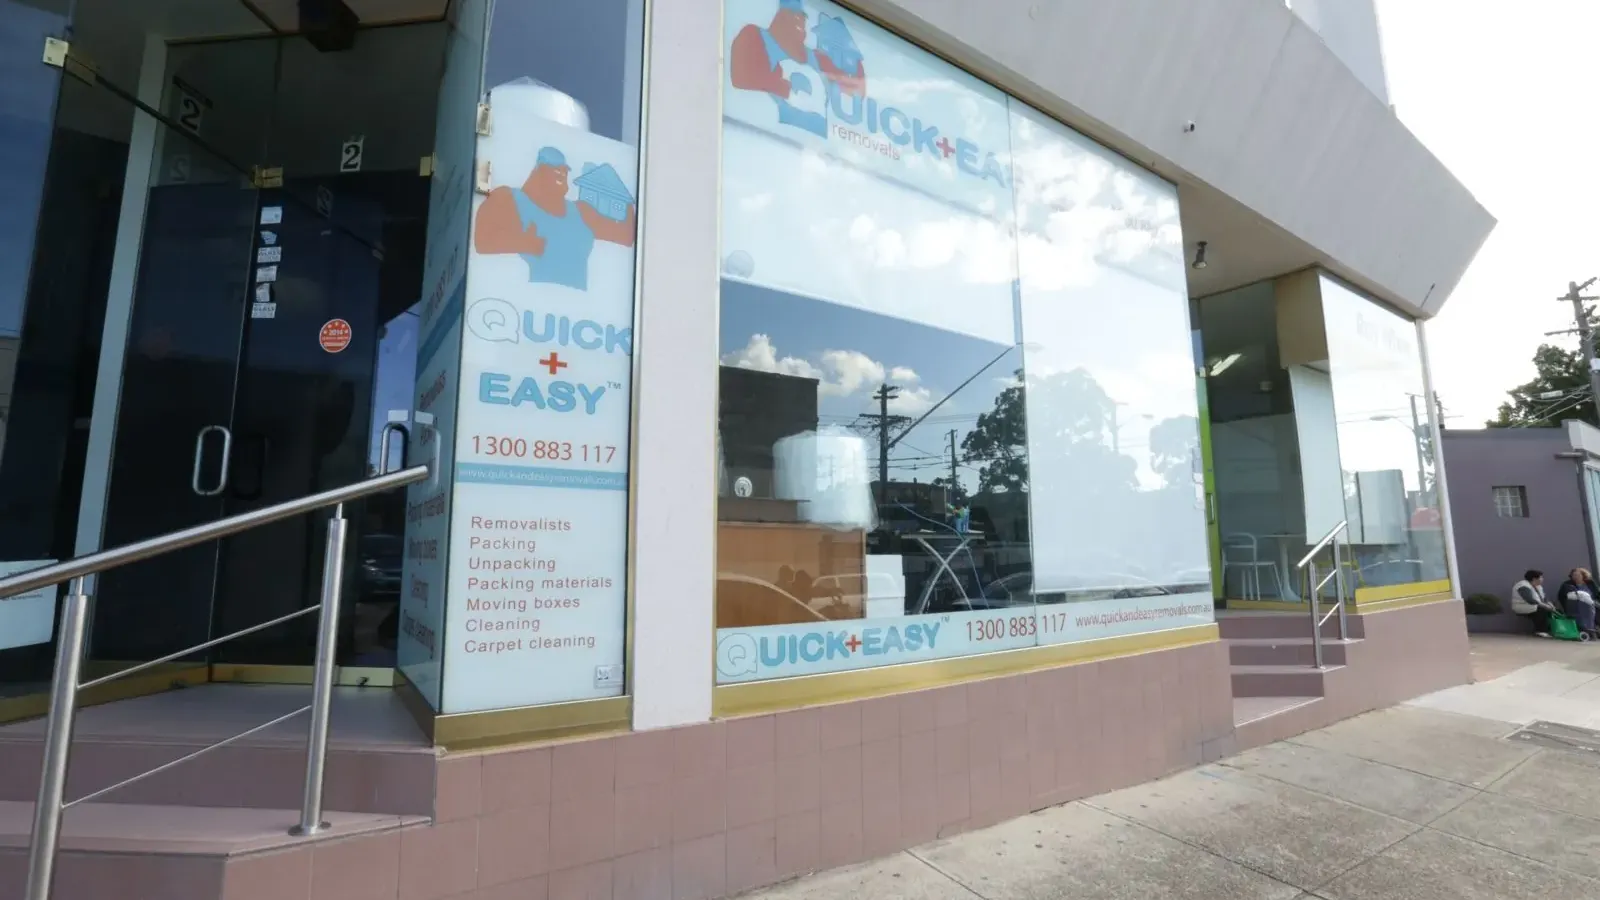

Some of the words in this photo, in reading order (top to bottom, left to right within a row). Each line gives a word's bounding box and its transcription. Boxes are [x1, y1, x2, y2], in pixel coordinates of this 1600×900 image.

[831, 123, 900, 162] removals
[343, 144, 360, 170] 2
[466, 297, 632, 356] QUICK
[479, 372, 606, 415] EASY
[472, 435, 527, 457] 1300
[533, 439, 572, 462] 883
[581, 444, 616, 463] 117
[471, 516, 572, 531] Removalists
[470, 537, 536, 552] Packing
[469, 557, 556, 572] Unpacking
[468, 577, 534, 592] Packing
[541, 577, 612, 589] materials
[466, 597, 527, 612] Moving
[534, 597, 581, 609] boxes
[465, 617, 540, 632] Cleaning
[966, 618, 1005, 642] 1300
[1009, 615, 1037, 637] 883
[1043, 613, 1067, 633] 117
[464, 639, 522, 654] Carpet
[529, 635, 595, 650] cleaning
